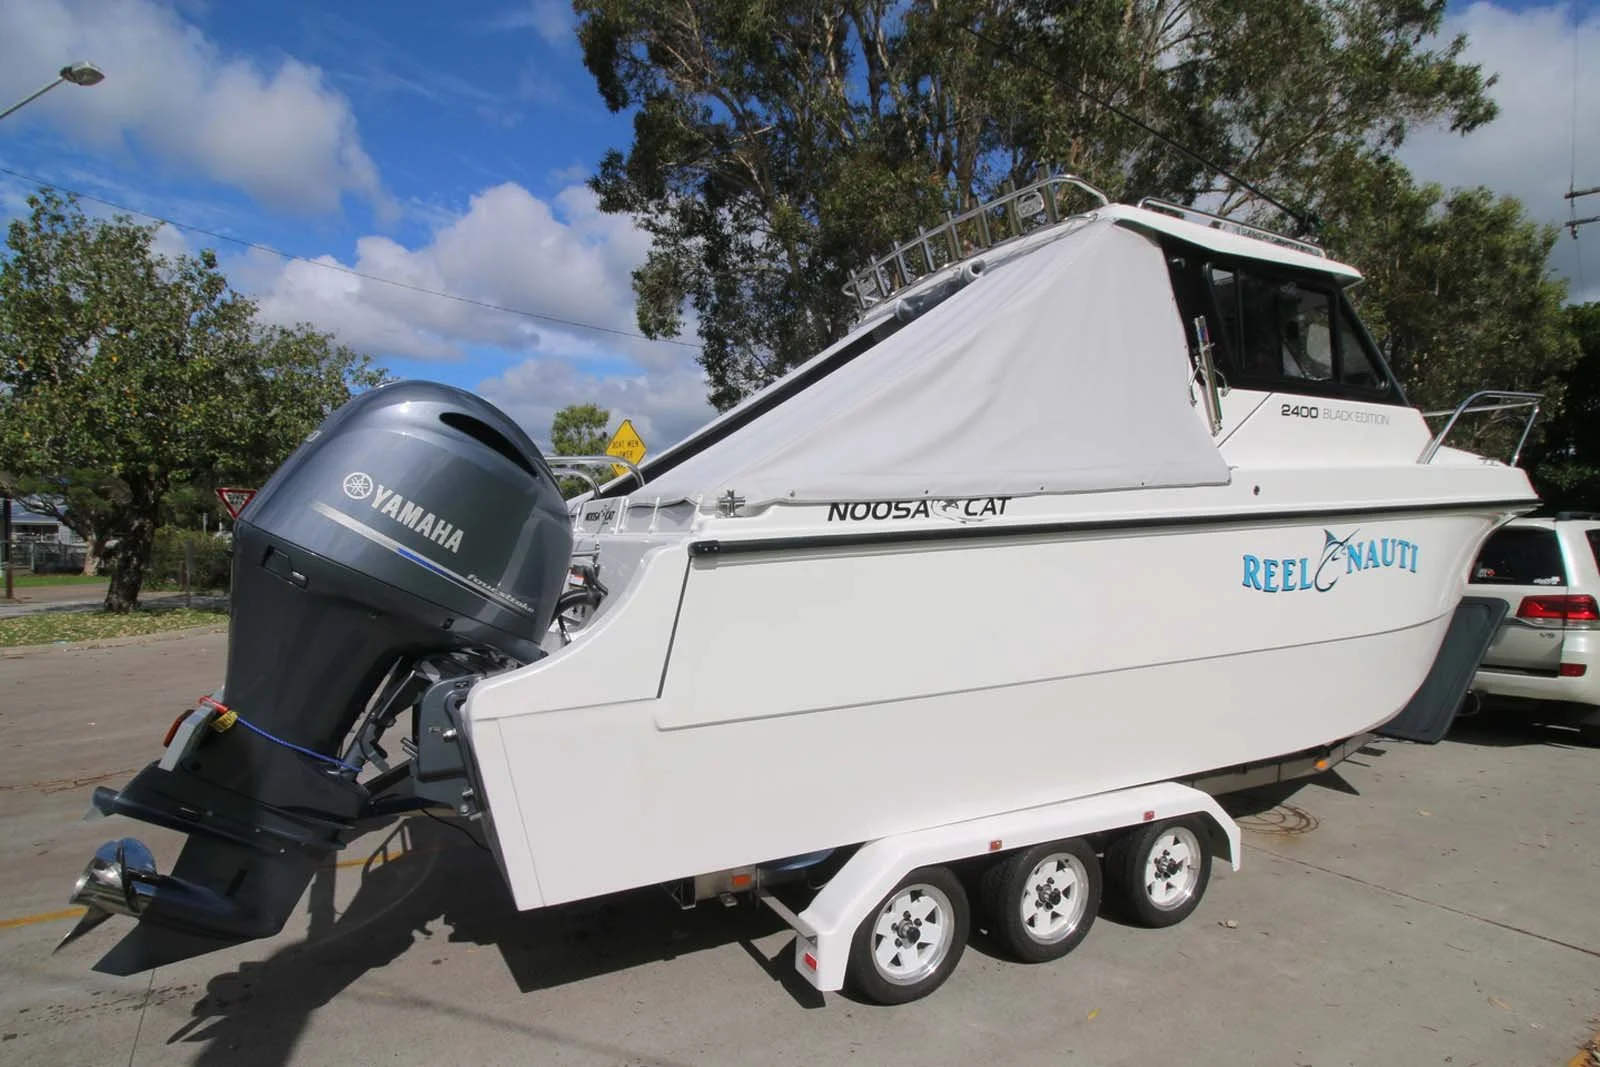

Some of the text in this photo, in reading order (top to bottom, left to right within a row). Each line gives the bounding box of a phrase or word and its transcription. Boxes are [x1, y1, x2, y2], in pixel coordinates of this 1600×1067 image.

[1281, 404, 1390, 425] 2400 BLACK EDITION
[370, 484, 465, 554] YAMAHA
[827, 496, 1012, 522] NOOSA CAT
[1242, 538, 1418, 593] REEL NAUTI
